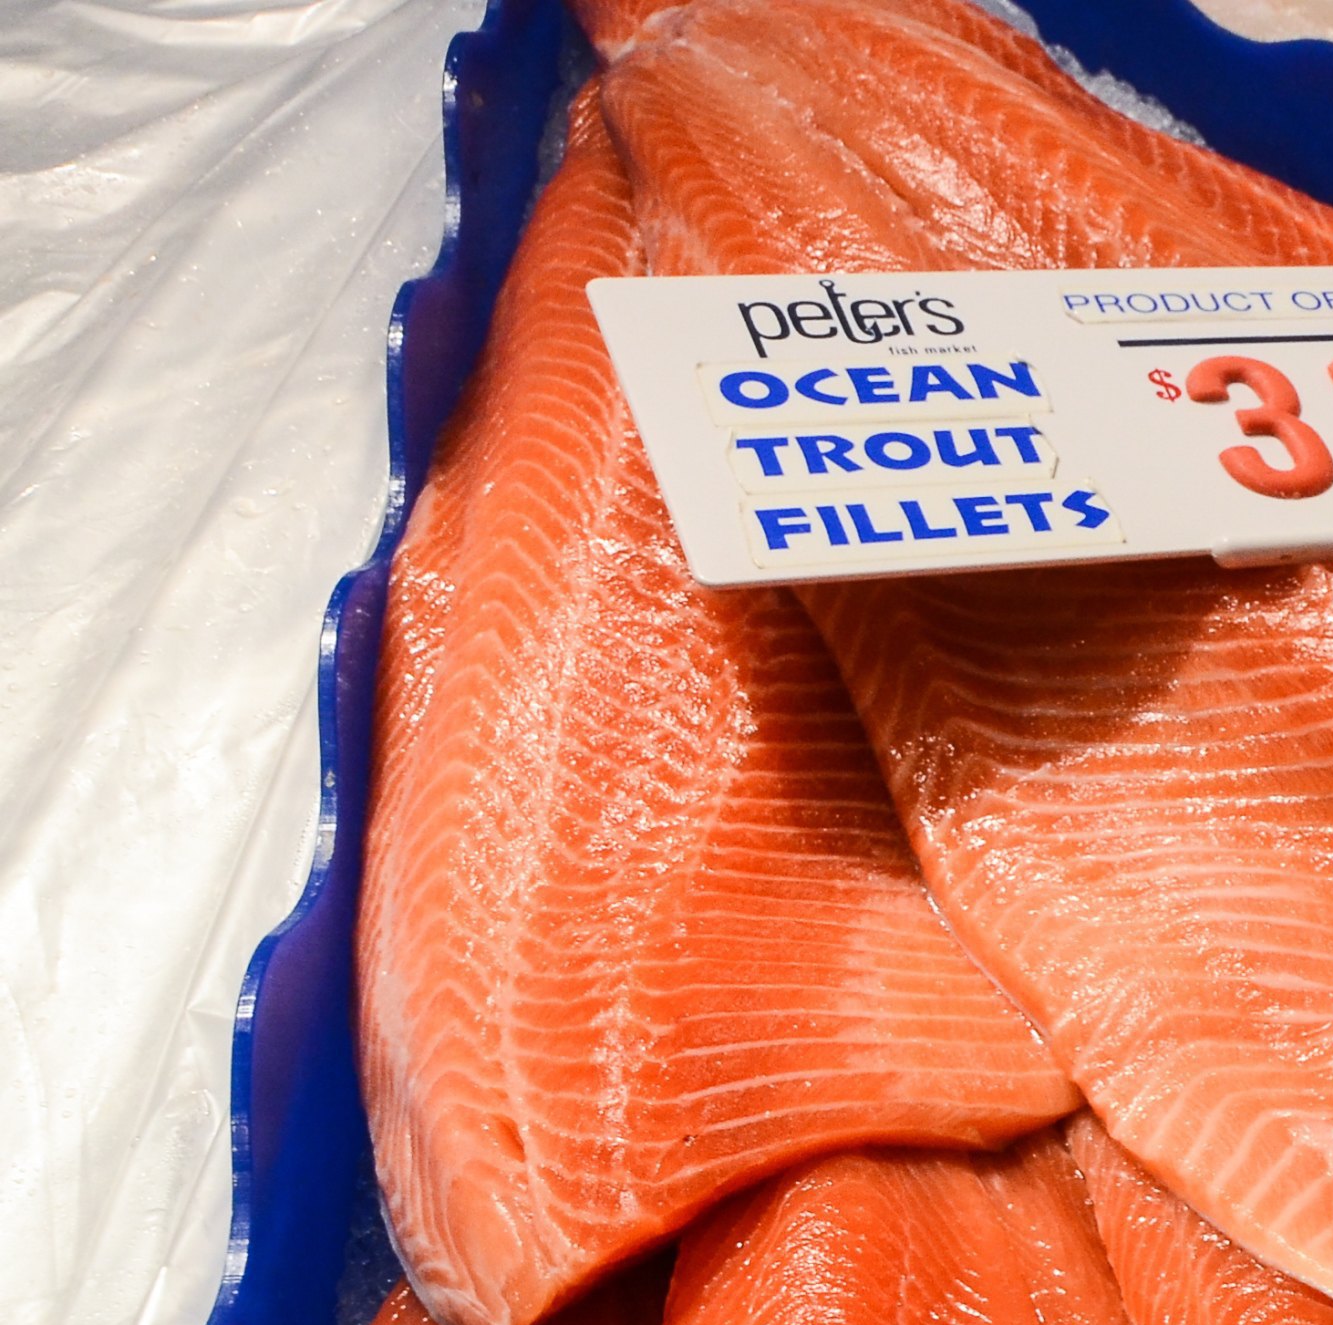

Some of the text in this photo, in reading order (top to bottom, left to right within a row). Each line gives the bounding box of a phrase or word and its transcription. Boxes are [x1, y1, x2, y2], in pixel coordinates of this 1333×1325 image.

[1063, 292, 1273, 315] PRODUCT
[889, 345, 977, 356] fish market
[719, 362, 1042, 408] OCEAN
[736, 426, 1044, 476] TROUT
[754, 489, 1110, 551] FILLETS
